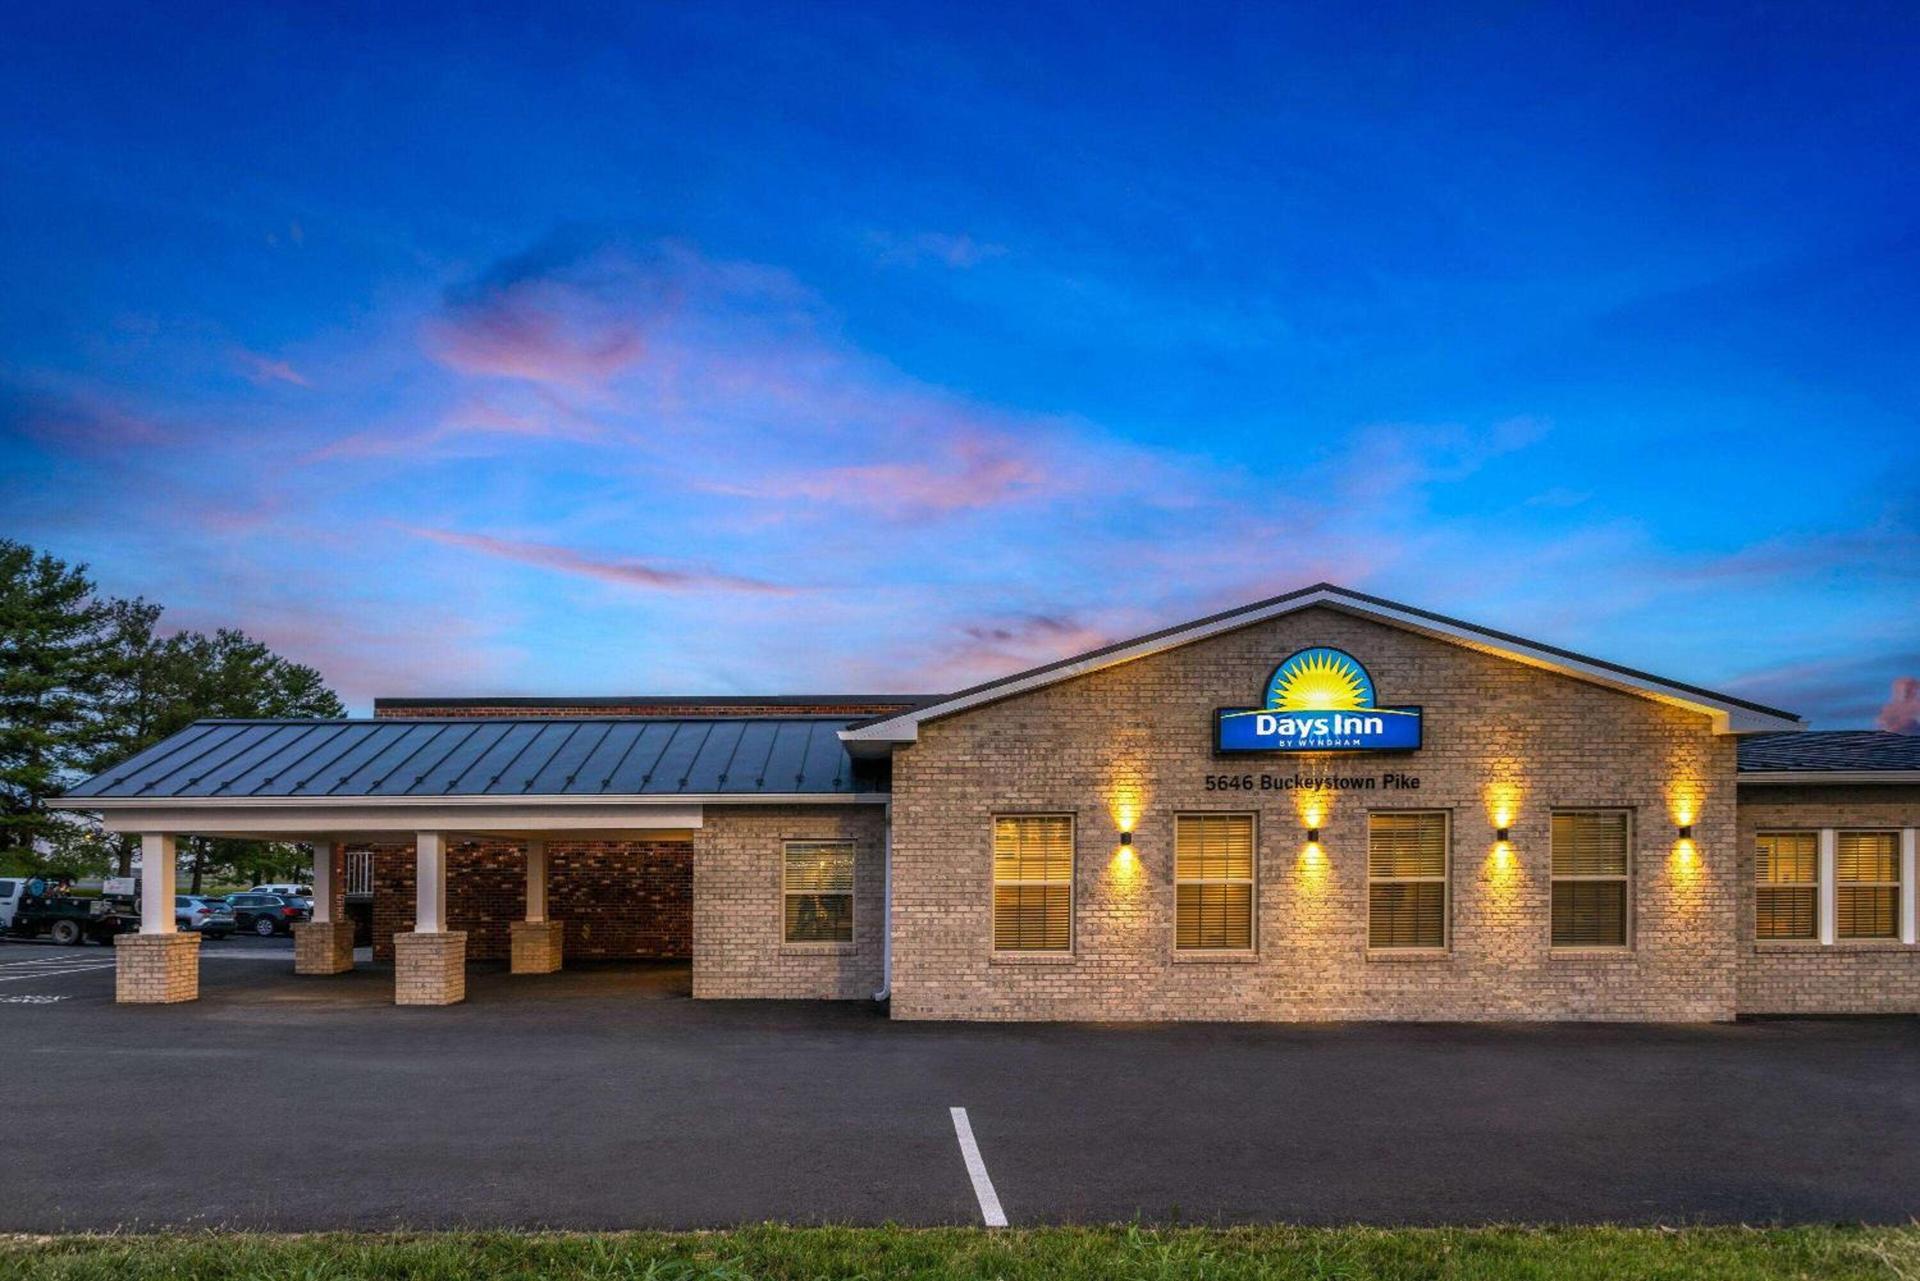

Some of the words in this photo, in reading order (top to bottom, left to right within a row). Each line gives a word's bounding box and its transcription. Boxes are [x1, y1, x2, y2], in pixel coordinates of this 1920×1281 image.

[1256, 714, 1327, 739] Days
[1334, 714, 1383, 734] Inn
[1298, 739, 1361, 747] WYNDHAM
[1205, 775, 1253, 791] 5646
[1260, 774, 1375, 791] Buckeystown
[1383, 774, 1420, 790] Pike
